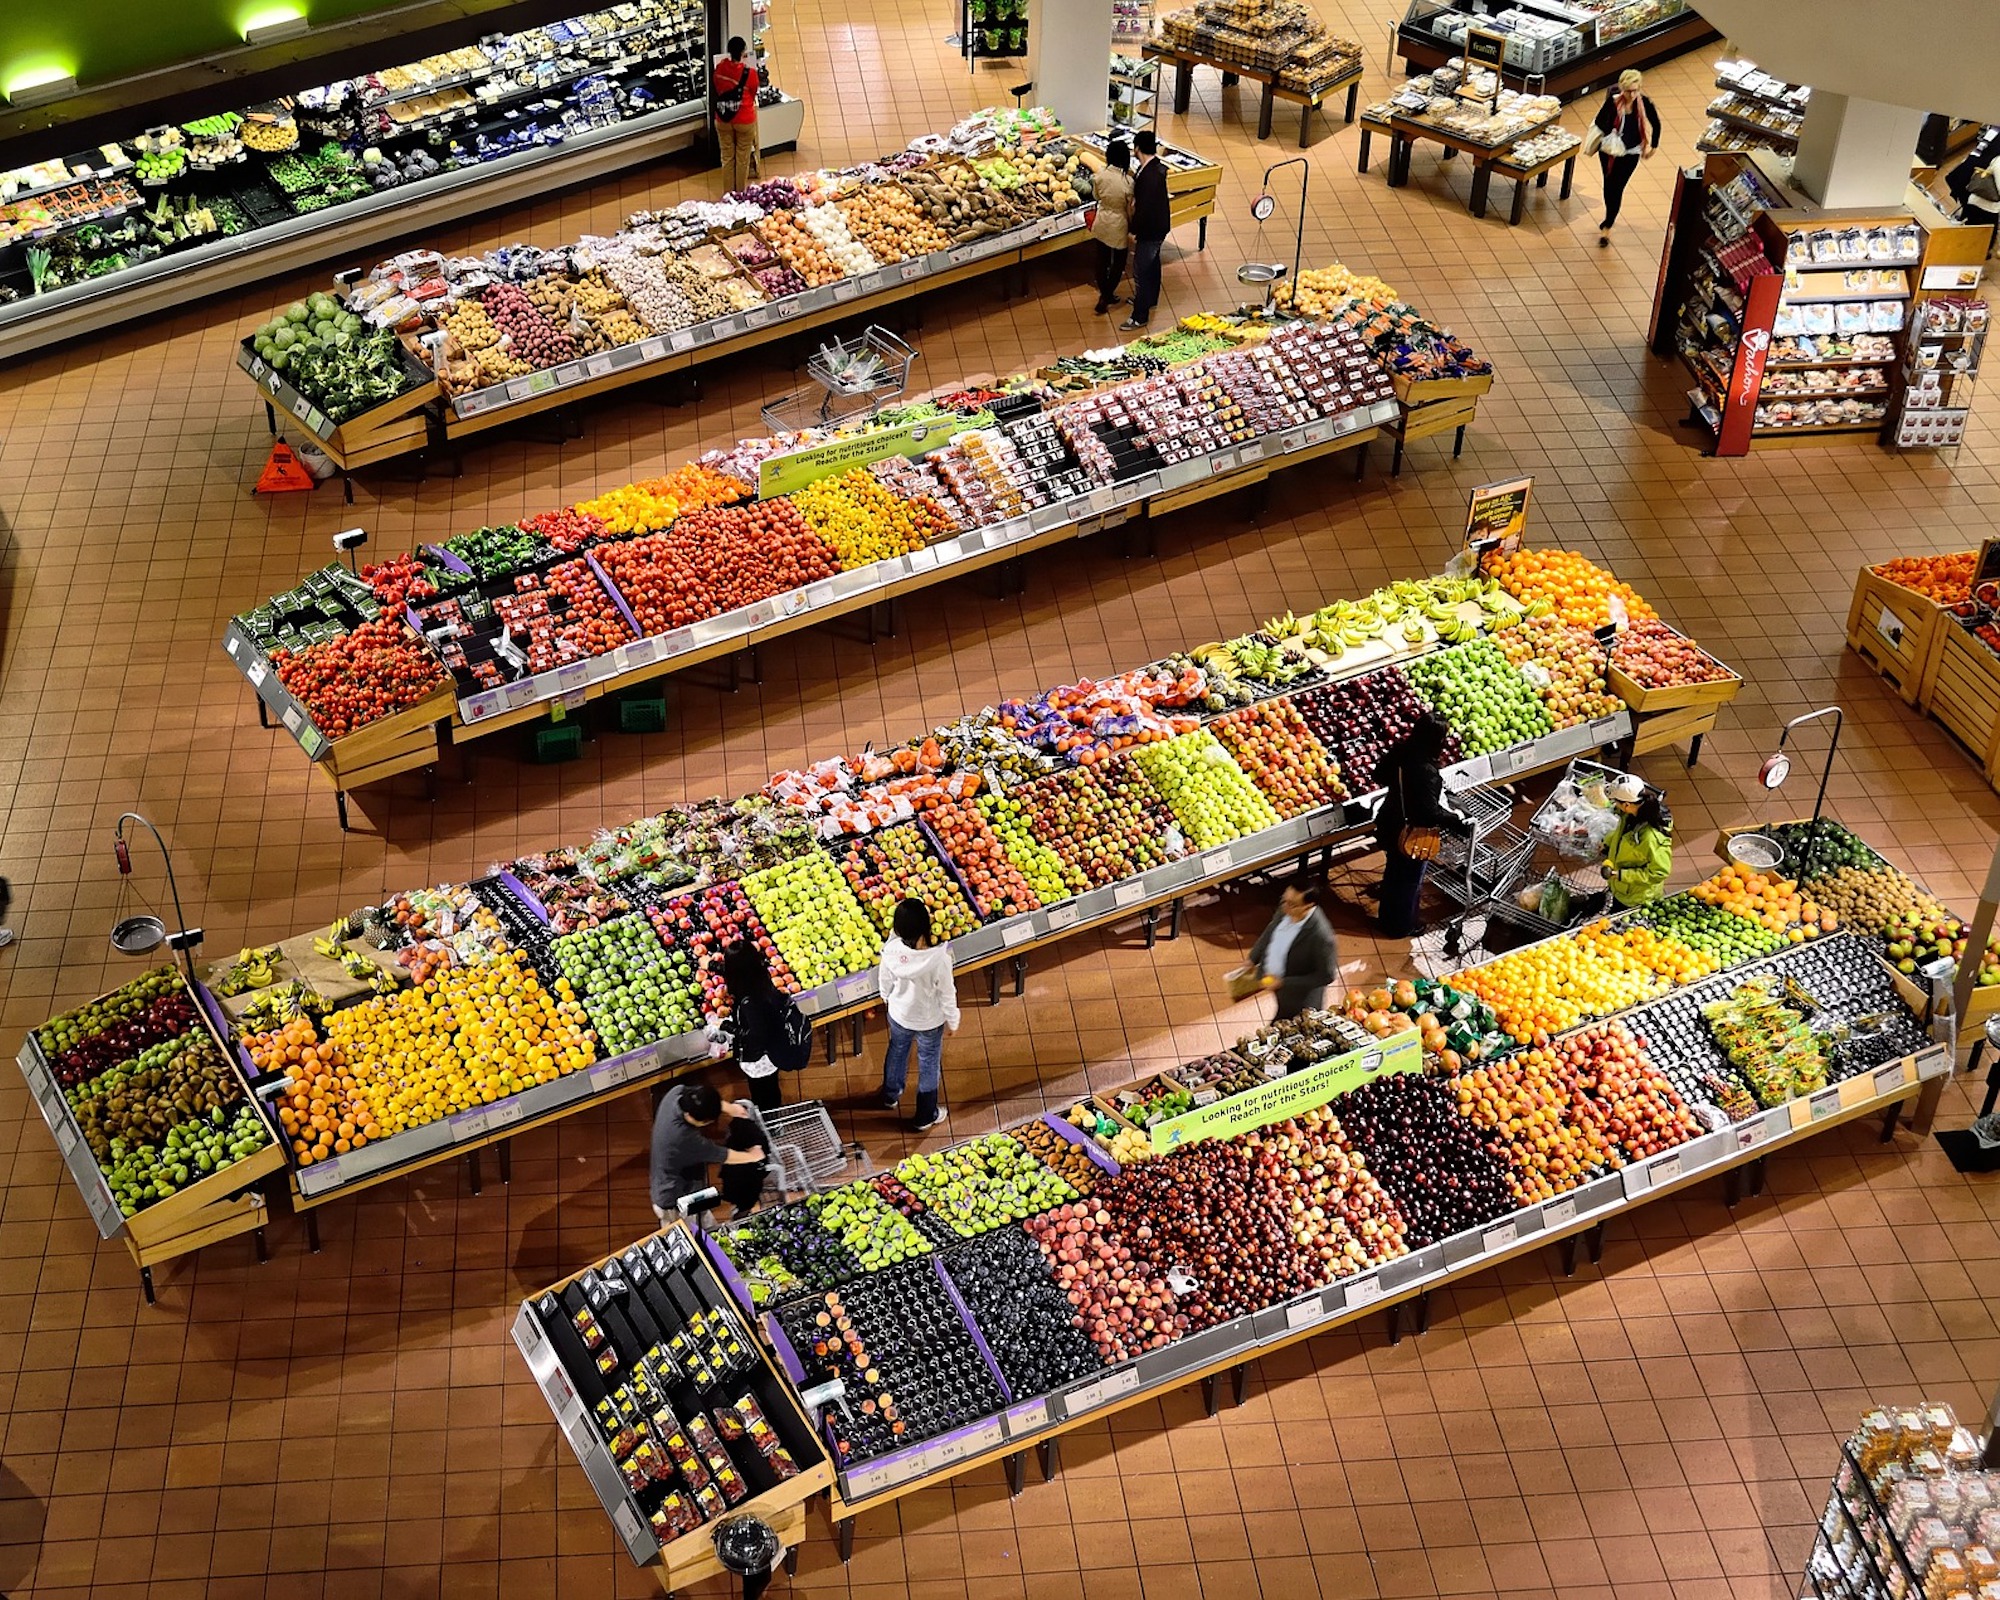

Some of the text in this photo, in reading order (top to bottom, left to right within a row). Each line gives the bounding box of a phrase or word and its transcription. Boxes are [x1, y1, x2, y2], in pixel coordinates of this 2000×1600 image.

[1740, 328, 1770, 406] Vachon
[796, 452, 824, 464] Looking
[826, 449, 837, 457] for
[838, 439, 875, 452] nutritious
[876, 430, 908, 444] choices?
[815, 456, 838, 466] Reach
[852, 449, 864, 457] the
[866, 443, 888, 454] Stars!
[1202, 1104, 1241, 1123] Looking
[1244, 1097, 1258, 1107] for
[1261, 1078, 1310, 1101] nutritious
[1314, 1060, 1354, 1082] choices?
[1230, 1106, 1260, 1123] Reach
[1264, 1100, 1276, 1110] for
[1280, 1093, 1296, 1104] the
[1300, 1080, 1329, 1097] Stars!
